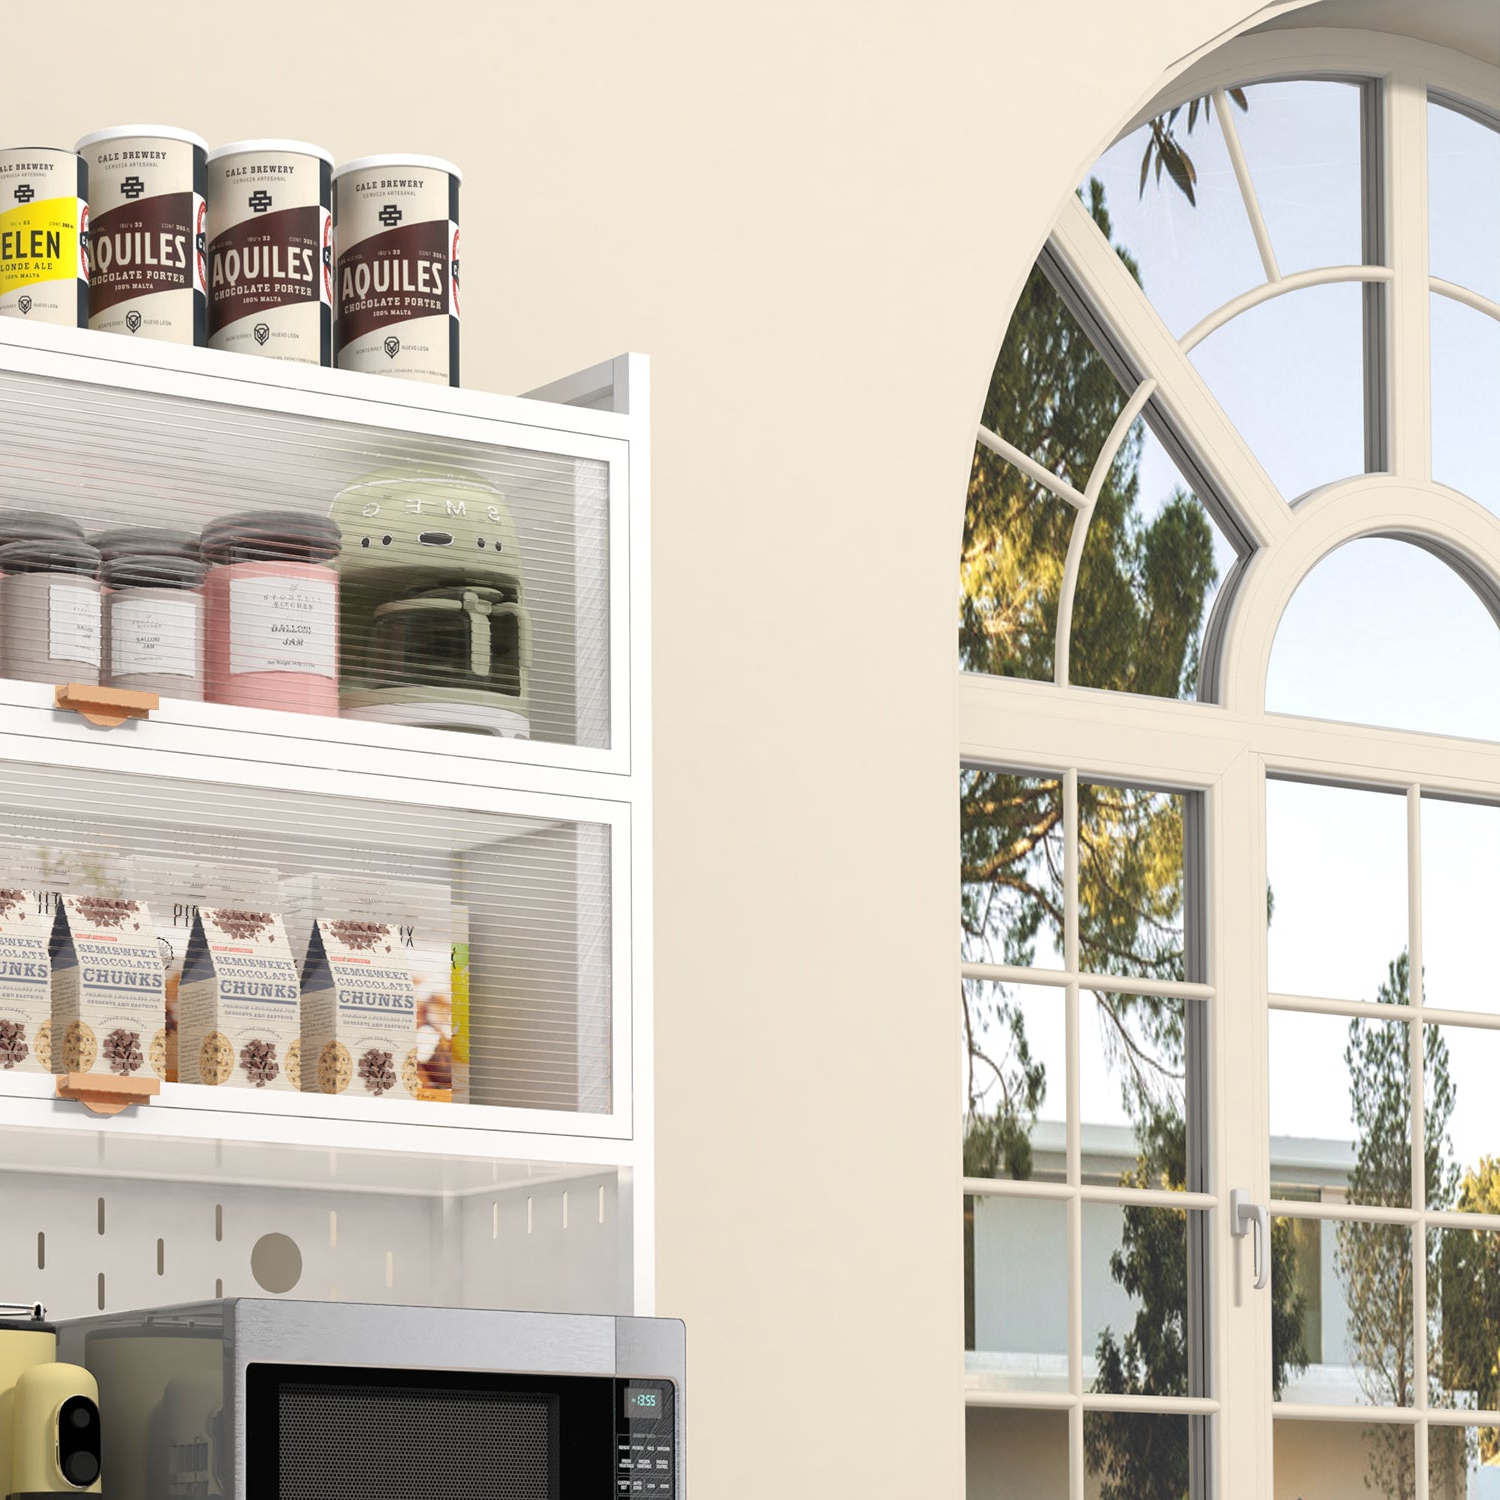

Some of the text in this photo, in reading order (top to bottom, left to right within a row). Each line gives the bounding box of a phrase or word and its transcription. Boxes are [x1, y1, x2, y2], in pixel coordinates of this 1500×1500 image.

[98, 151, 167, 164] CALE BREWERY
[226, 166, 294, 178] CALE BREWERY
[356, 180, 424, 192] CALE BREWERY
[88, 232, 186, 272] AQUILES
[34, 262, 52, 270] ALE
[212, 245, 313, 288] AQUILES
[147, 270, 185, 284] PORTER
[342, 259, 442, 300] AQUILES
[214, 284, 312, 300] CHOCOLATE PORTER
[344, 297, 442, 314] CHOCOLATE PORTER
[283, 638, 304, 646] JAM
[78, 944, 157, 958] SEMISWEET
[82, 955, 160, 970] CHOCOLATE
[216, 956, 292, 970] SEMISWEET
[83, 968, 162, 988] CHUNKS
[218, 967, 296, 982] CHOCOLATE
[334, 966, 409, 980] SEMISWEET
[220, 980, 298, 999] CHUNKS
[337, 978, 414, 992] CHOCOLATE
[339, 990, 414, 1009] CHUNKS
